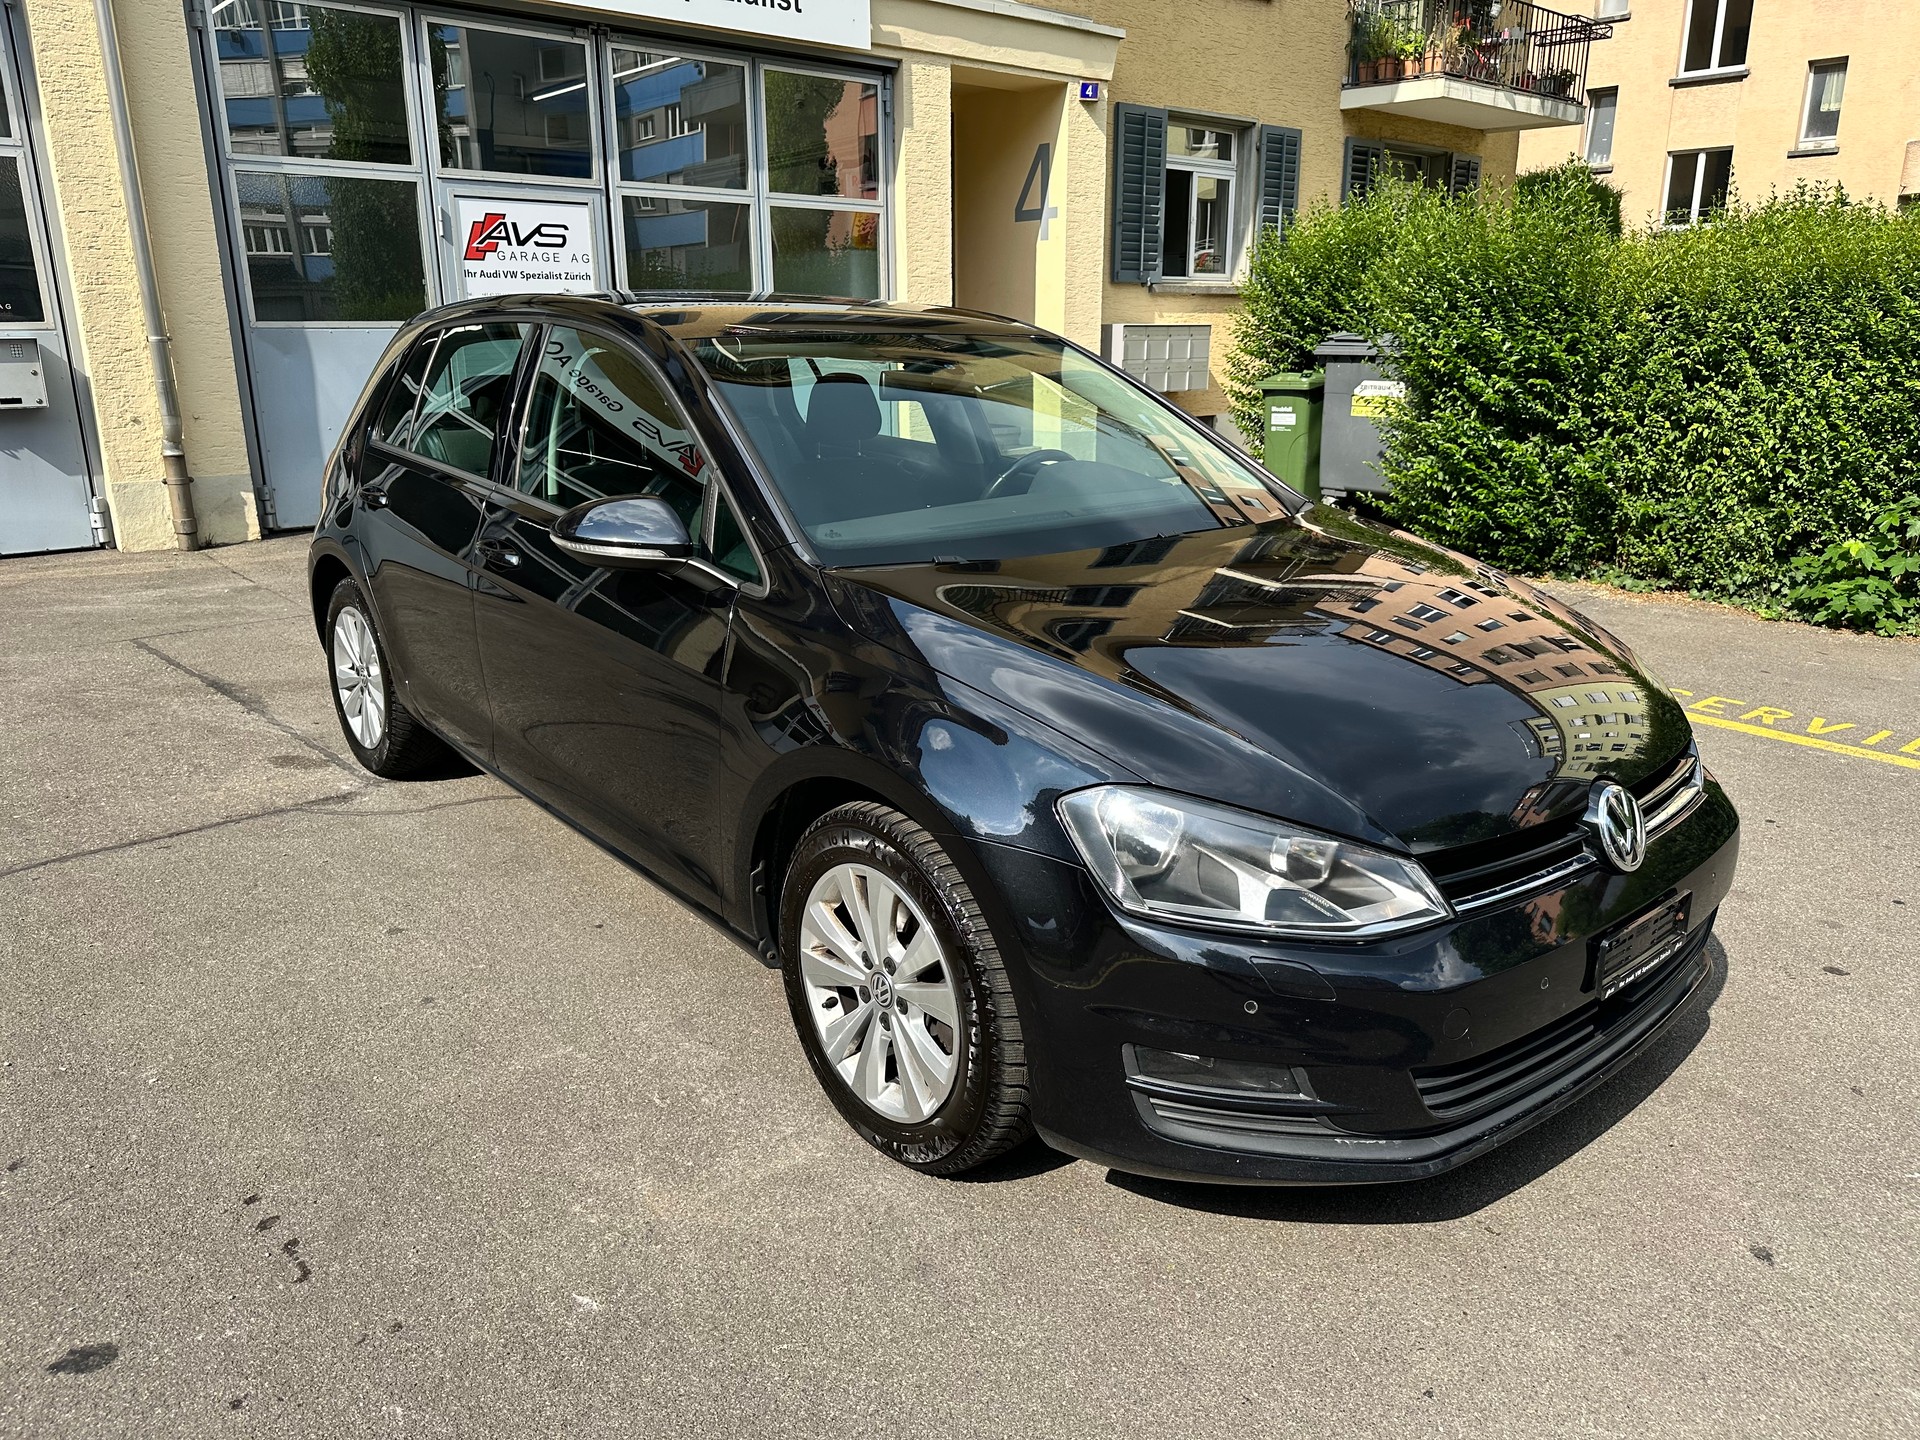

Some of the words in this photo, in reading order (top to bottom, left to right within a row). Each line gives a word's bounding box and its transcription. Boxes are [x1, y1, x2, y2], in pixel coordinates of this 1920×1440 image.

[1085, 85, 1093, 98] 4
[1014, 142, 1058, 241] 4
[475, 220, 569, 249] AVS
[497, 250, 561, 263] GARAGE
[570, 253, 590, 264] AG
[463, 269, 477, 279] Ihr
[479, 270, 501, 279] Audi
[502, 271, 518, 280] VW
[520, 271, 563, 281] Spezialist
[564, 272, 591, 281] Zürich
[1669, 687, 1920, 755] ERVI
